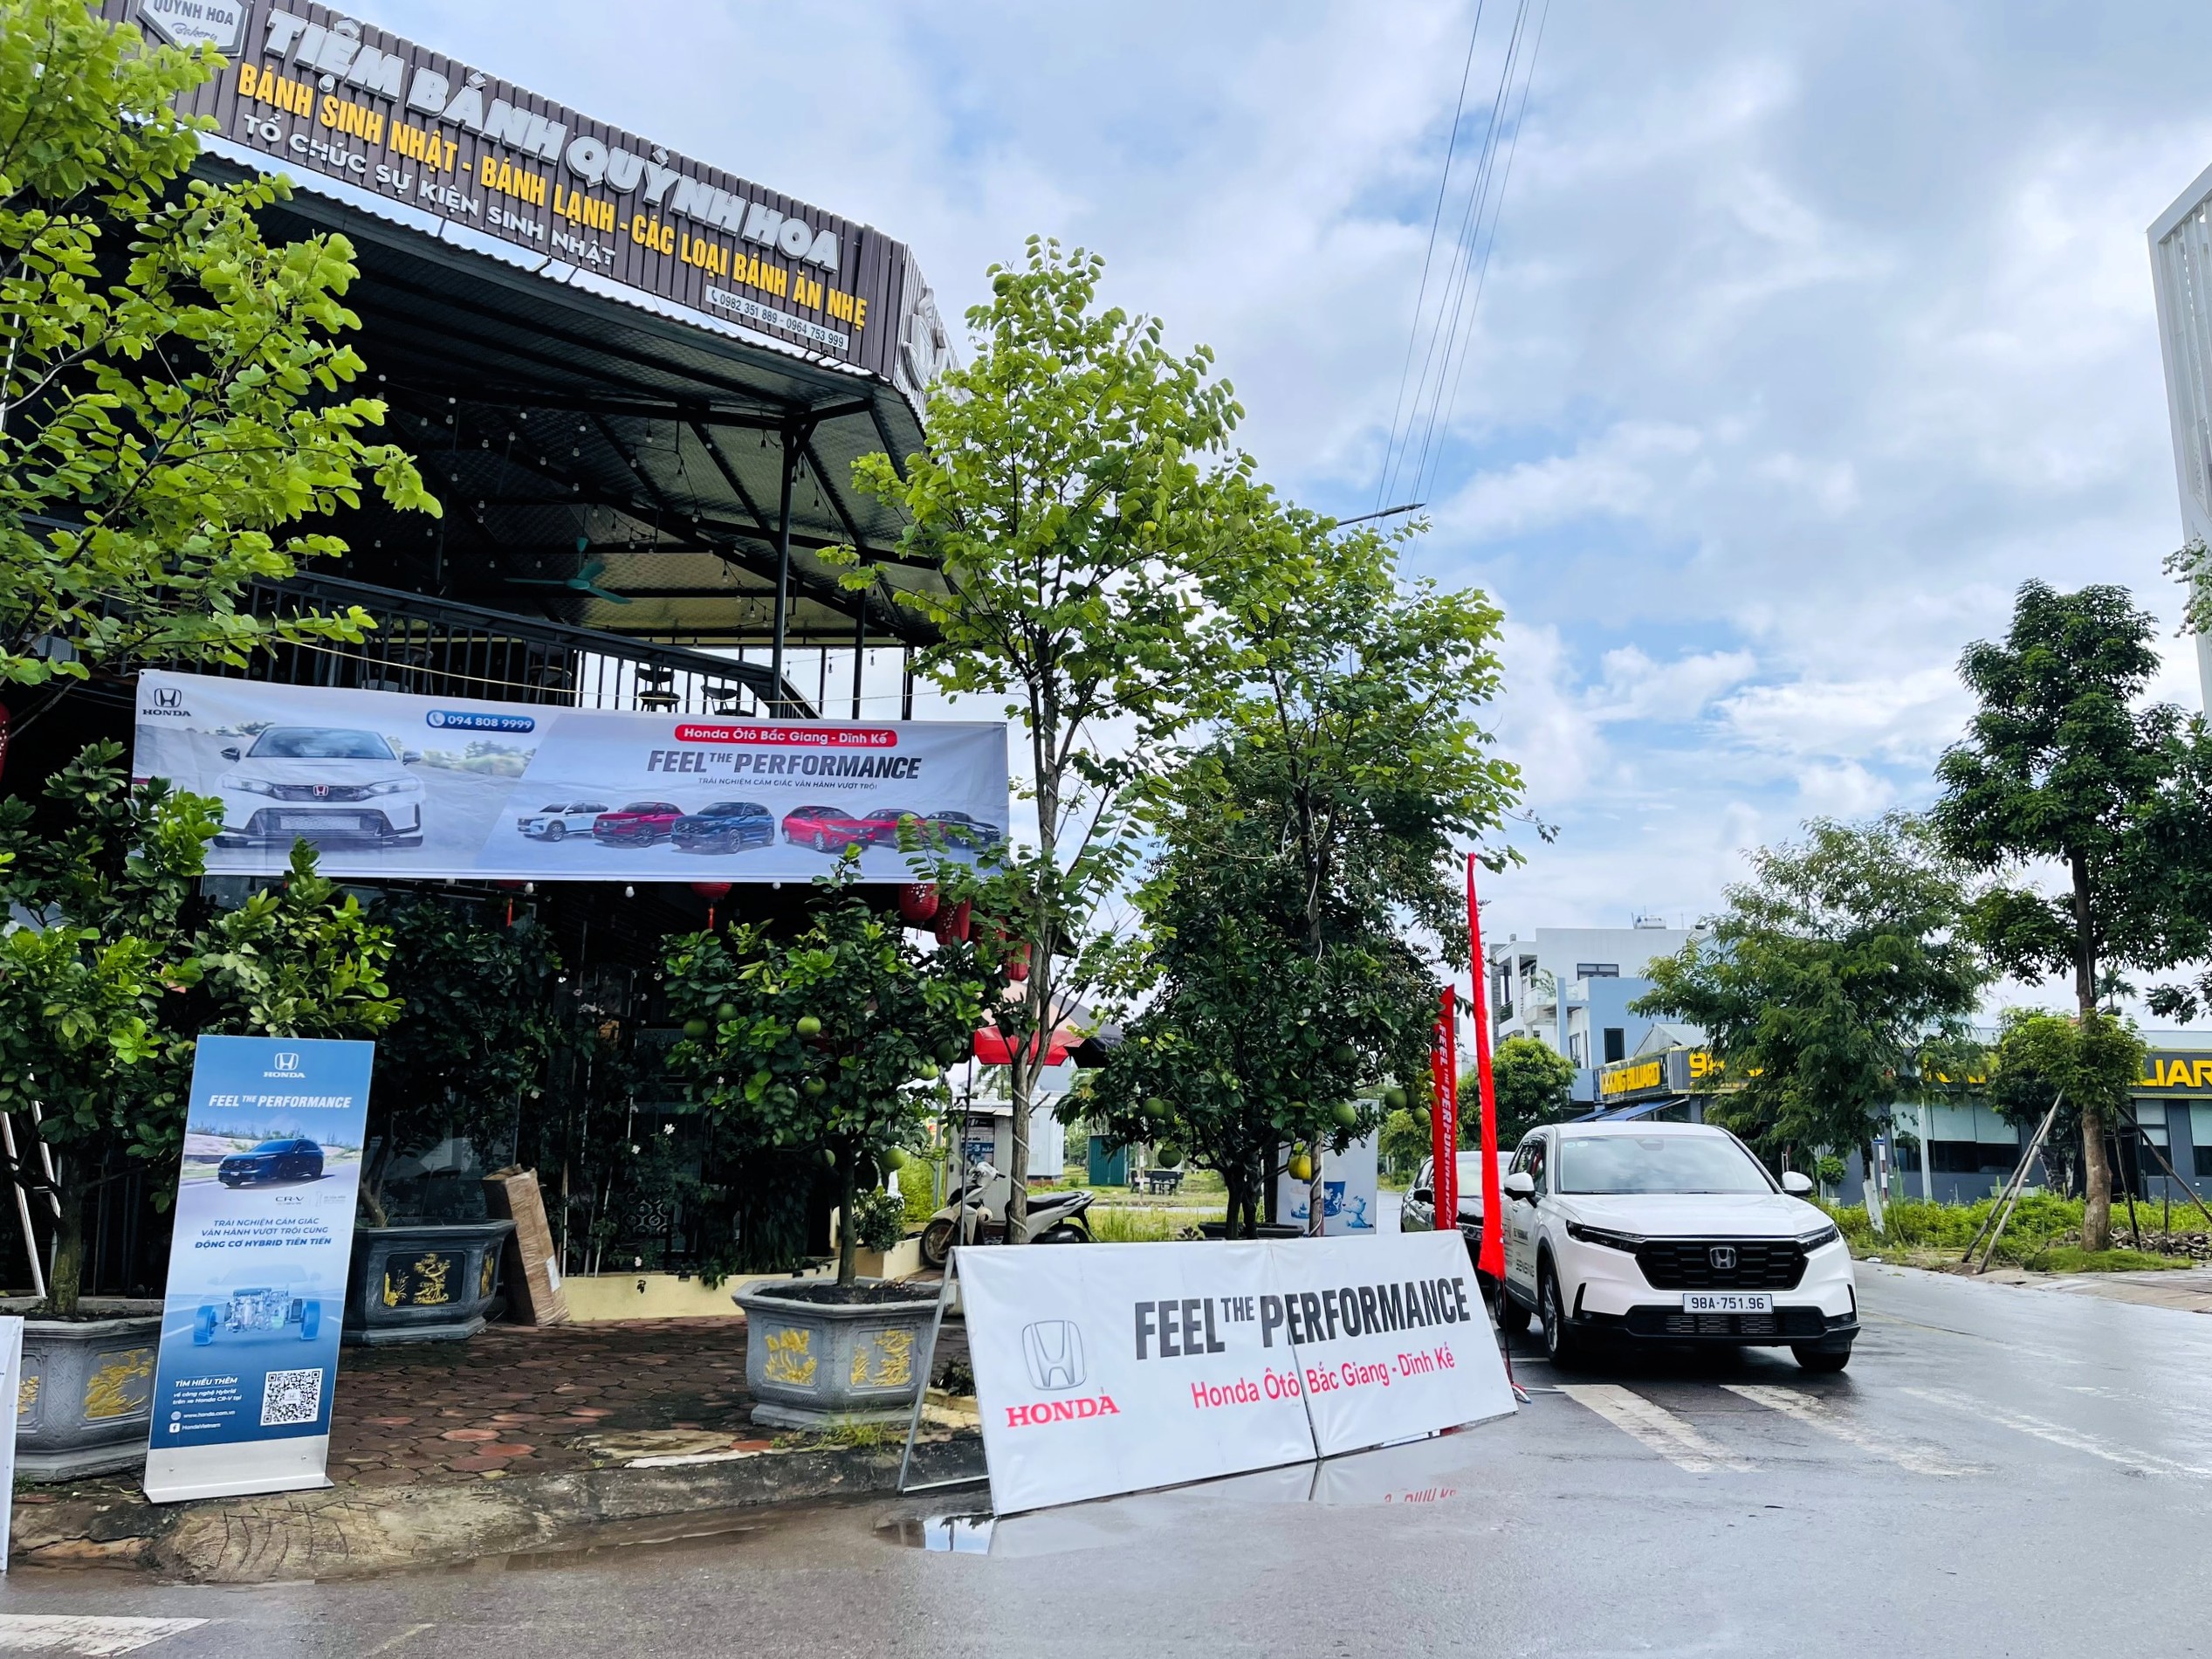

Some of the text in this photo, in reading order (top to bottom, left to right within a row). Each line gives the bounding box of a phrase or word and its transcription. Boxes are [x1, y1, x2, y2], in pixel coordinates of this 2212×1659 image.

[205, 6, 233, 25] HOA
[171, 22, 217, 41] Bakery
[264, 7, 405, 103] TIỆM
[566, 136, 747, 236] QUỲNH
[741, 201, 839, 275] HOA
[238, 62, 314, 119] BÁNH
[320, 94, 384, 145] SINH
[389, 120, 458, 173] NHẬT
[480, 155, 546, 208] BÁNH
[553, 183, 615, 233] LẠNH
[631, 213, 675, 256] CÁC
[681, 231, 729, 279] LOẠI
[732, 252, 788, 299] BÁNH
[792, 269, 821, 312] ĂN
[827, 288, 868, 332] NHẸ
[244, 113, 615, 266] TỔ CHỨC SỰ KIỆN SINH NHẬT
[720, 293, 741, 311] 0982
[744, 302, 759, 317] 351
[762, 309, 778, 324] 889
[787, 320, 807, 334] 0964
[810, 327, 825, 341] 753
[828, 333, 844, 348] 999
[142, 708, 191, 718] HONDA
[447, 714, 532, 730] 094 808 9999
[684, 727, 729, 740] Honda
[732, 727, 757, 740] Ôtô
[760, 727, 786, 741] Bắc
[789, 731, 828, 745] Giang
[839, 732, 867, 744] Dĩnh
[871, 732, 888, 744] Kế
[648, 750, 922, 781] FEEL THE PERFORMANCE
[1439, 1023, 1448, 1066] FEEL
[209, 1095, 239, 1107] FEEL
[258, 1095, 352, 1108] PERFORMANCE
[195, 1240, 225, 1250] ĐỘNG
[228, 1239, 244, 1248] CƠ
[1691, 1297, 1764, 1310] 98A-751.96
[1135, 1277, 1472, 1360] FEEL THE PERFORMANCE
[214, 1376, 238, 1385] THÊM
[1191, 1377, 1260, 1408] Honda
[1264, 1366, 1301, 1400] Ôtô
[1306, 1361, 1339, 1394] Bắc
[1341, 1360, 1390, 1387] Giang
[1398, 1350, 1433, 1377] Dĩnh
[1434, 1341, 1455, 1369] Kế
[1005, 1396, 1121, 1429] HONDA
